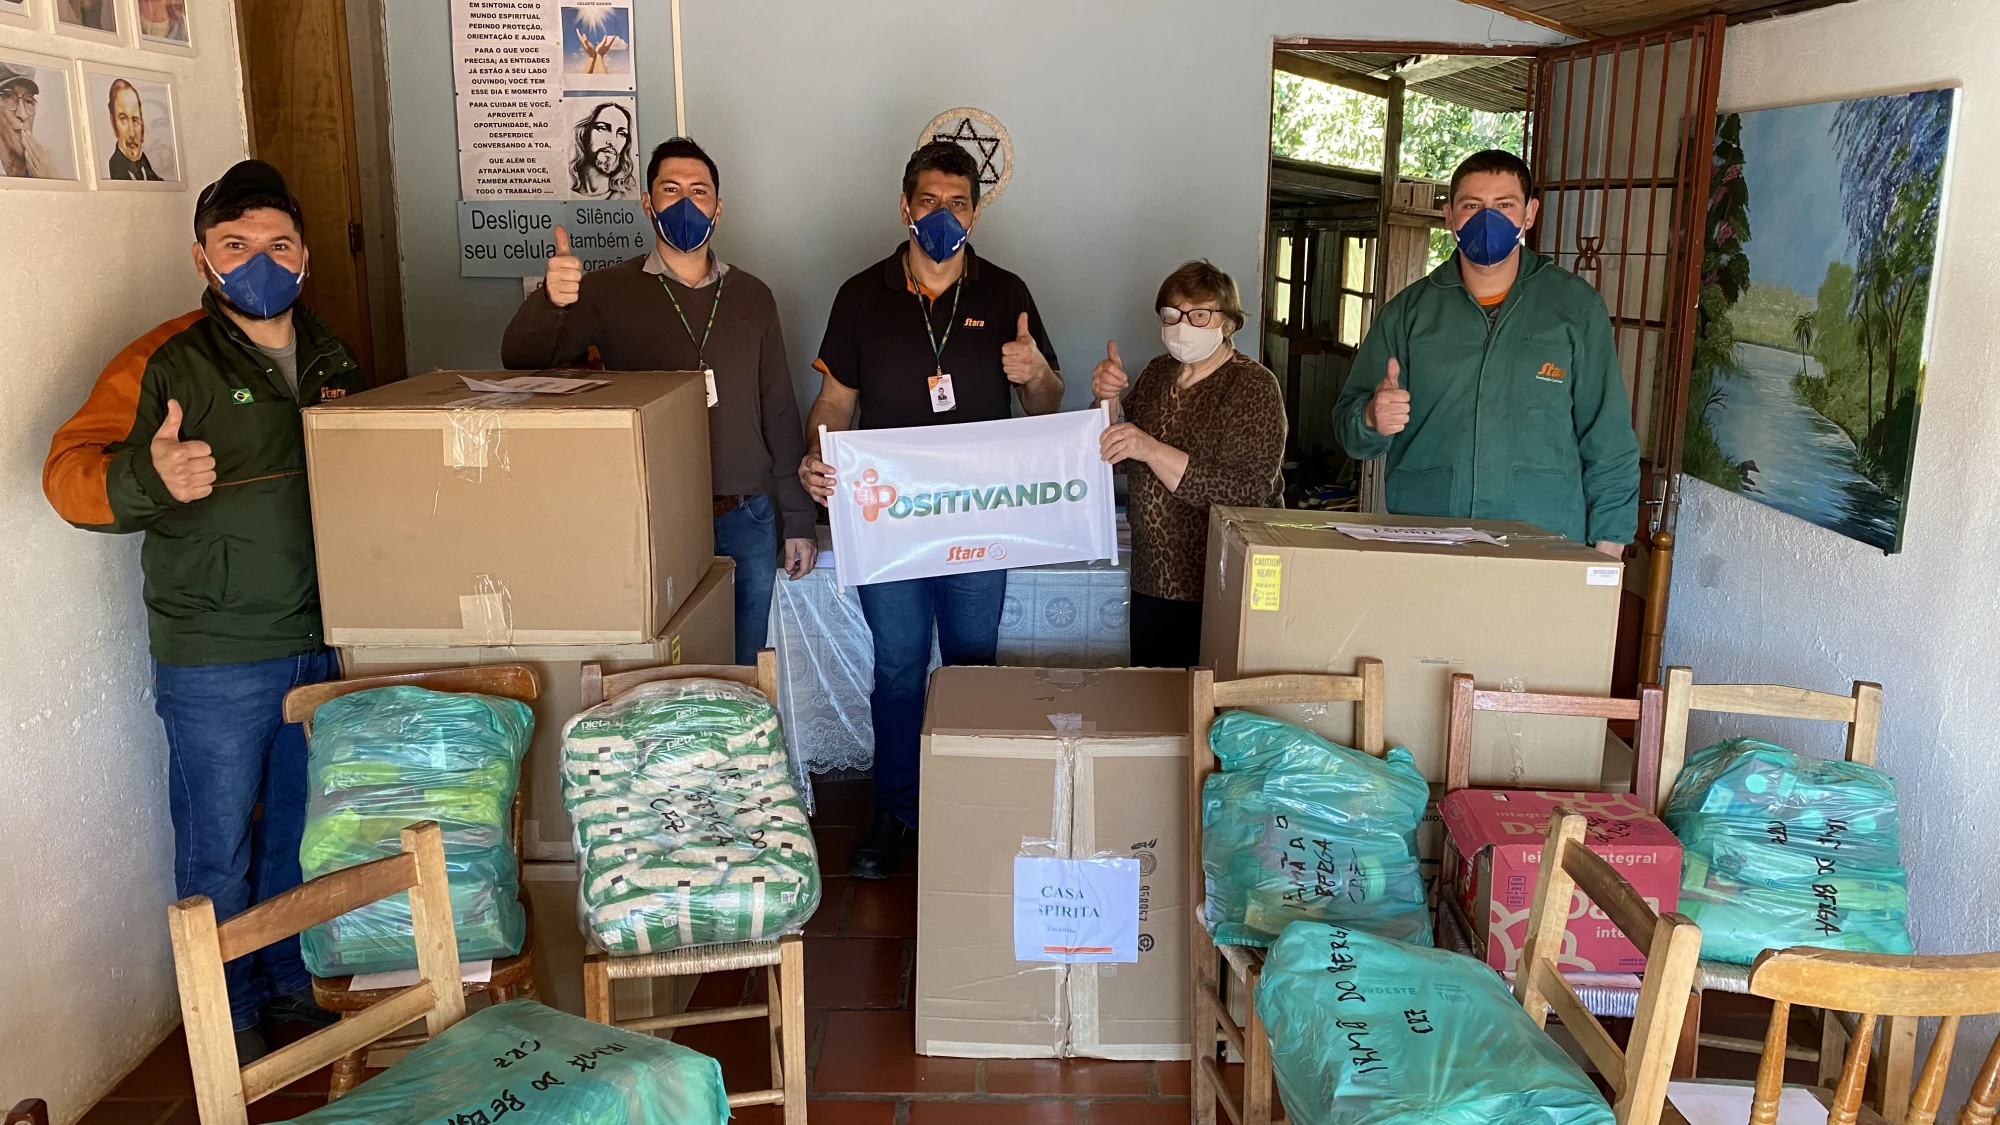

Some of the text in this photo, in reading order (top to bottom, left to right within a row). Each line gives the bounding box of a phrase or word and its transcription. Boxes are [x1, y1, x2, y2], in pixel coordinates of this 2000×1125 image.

[472, 210, 552, 234] Desligue
[576, 208, 634, 225] Silêncio
[570, 232, 644, 249] também é
[464, 240, 556, 259] seu celula
[963, 318, 985, 327] Stara
[857, 479, 1088, 522] POSITIVANDO
[946, 546, 985, 561] Stara
[1254, 557, 1280, 567] CAUTION
[1256, 569, 1276, 578] HEAVY
[1522, 851, 1657, 867] lei ntegral
[1041, 886, 1085, 900] CASA
[1334, 980, 1366, 1003] DO
[531, 1071, 566, 1091] DO
